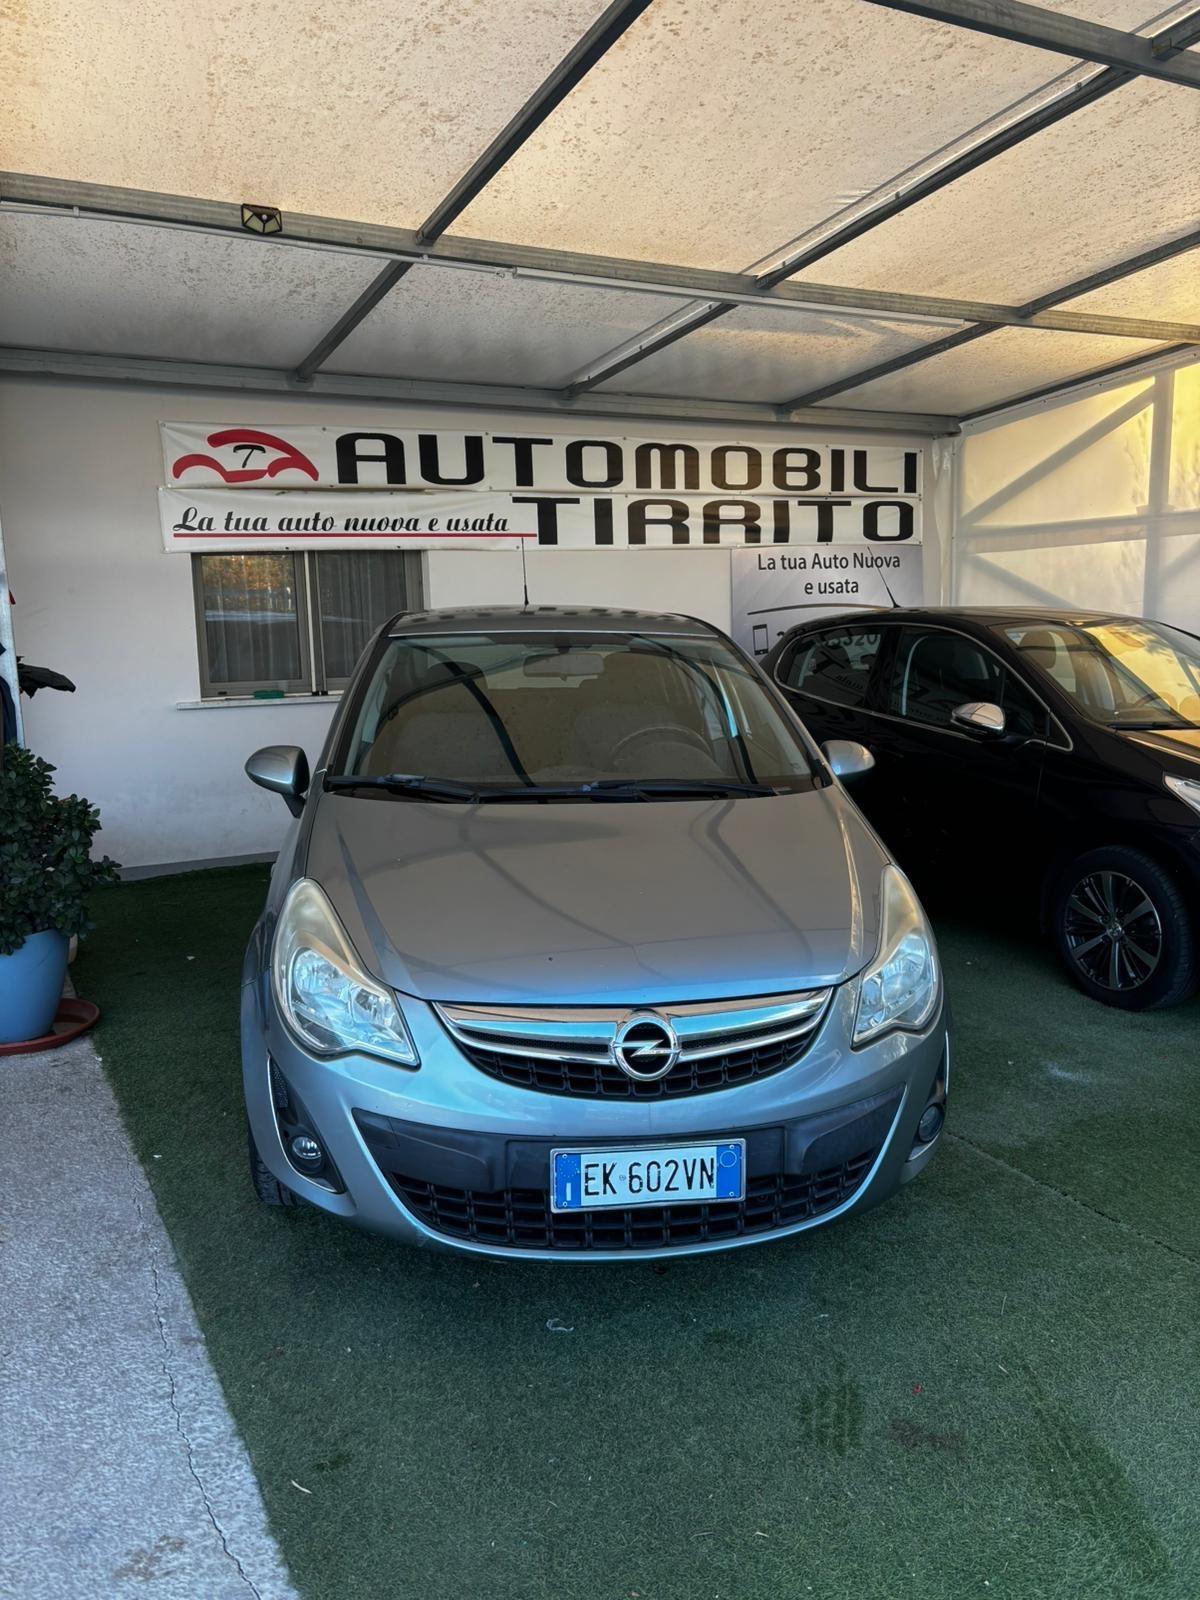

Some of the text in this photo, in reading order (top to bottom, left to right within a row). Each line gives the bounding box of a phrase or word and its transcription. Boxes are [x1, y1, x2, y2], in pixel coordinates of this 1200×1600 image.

[335, 432, 918, 495] AUTOMOBILI
[172, 506, 510, 532] La tua auto nuova e usata
[512, 496, 914, 546] TIRRITO
[758, 552, 901, 571] La tua Auto Nuova
[804, 578, 859, 595] e usata
[584, 1157, 715, 1196] EK 602VN
